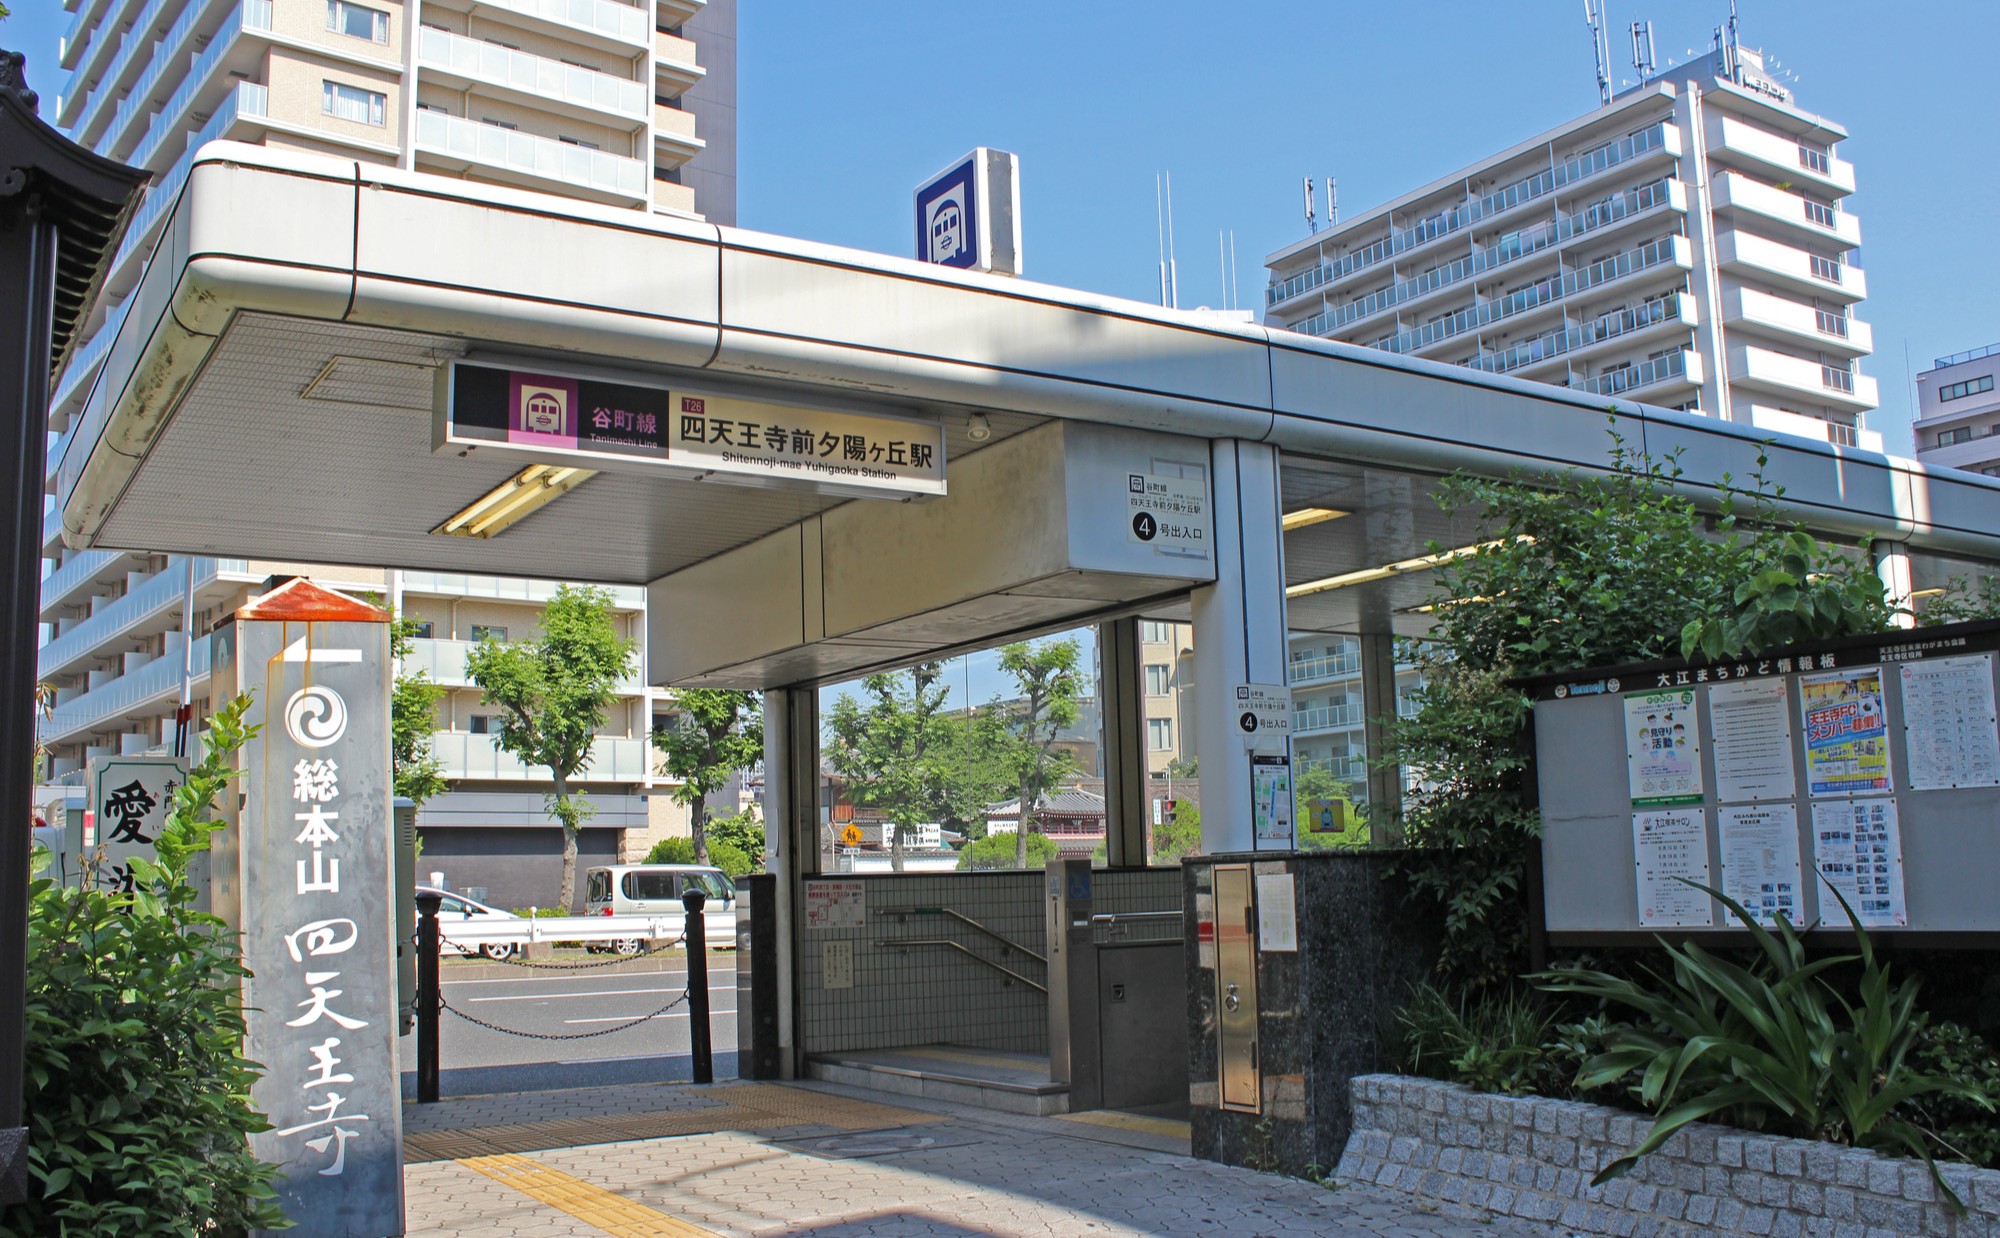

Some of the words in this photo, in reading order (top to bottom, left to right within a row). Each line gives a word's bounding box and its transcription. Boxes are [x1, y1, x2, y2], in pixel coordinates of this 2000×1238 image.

[685, 399, 702, 412] T26
[592, 406, 657, 434] 谷町線
[590, 433, 636, 447] Tanimachi
[639, 439, 658, 449] Line
[721, 451, 802, 470] Shitennoji-mae
[804, 461, 859, 477] Yuhigaoka
[861, 467, 897, 480] Station
[1146, 482, 1167, 493] 谷町線
[1138, 517, 1151, 536] 4
[1160, 523, 1202, 539] 号出入口
[1880, 651, 1922, 663] 天王寺区役所
[1657, 653, 1836, 688] 大江まちかど情報板
[1244, 715, 1254, 729] 4
[1260, 718, 1288, 729] 号出入口
[1808, 703, 1858, 727] 天王寺FC
[1650, 727, 1673, 738] 見守り
[1652, 738, 1673, 749] 活動
[293, 757, 340, 895] 総本山
[277, 917, 370, 1176] 四天王寺
